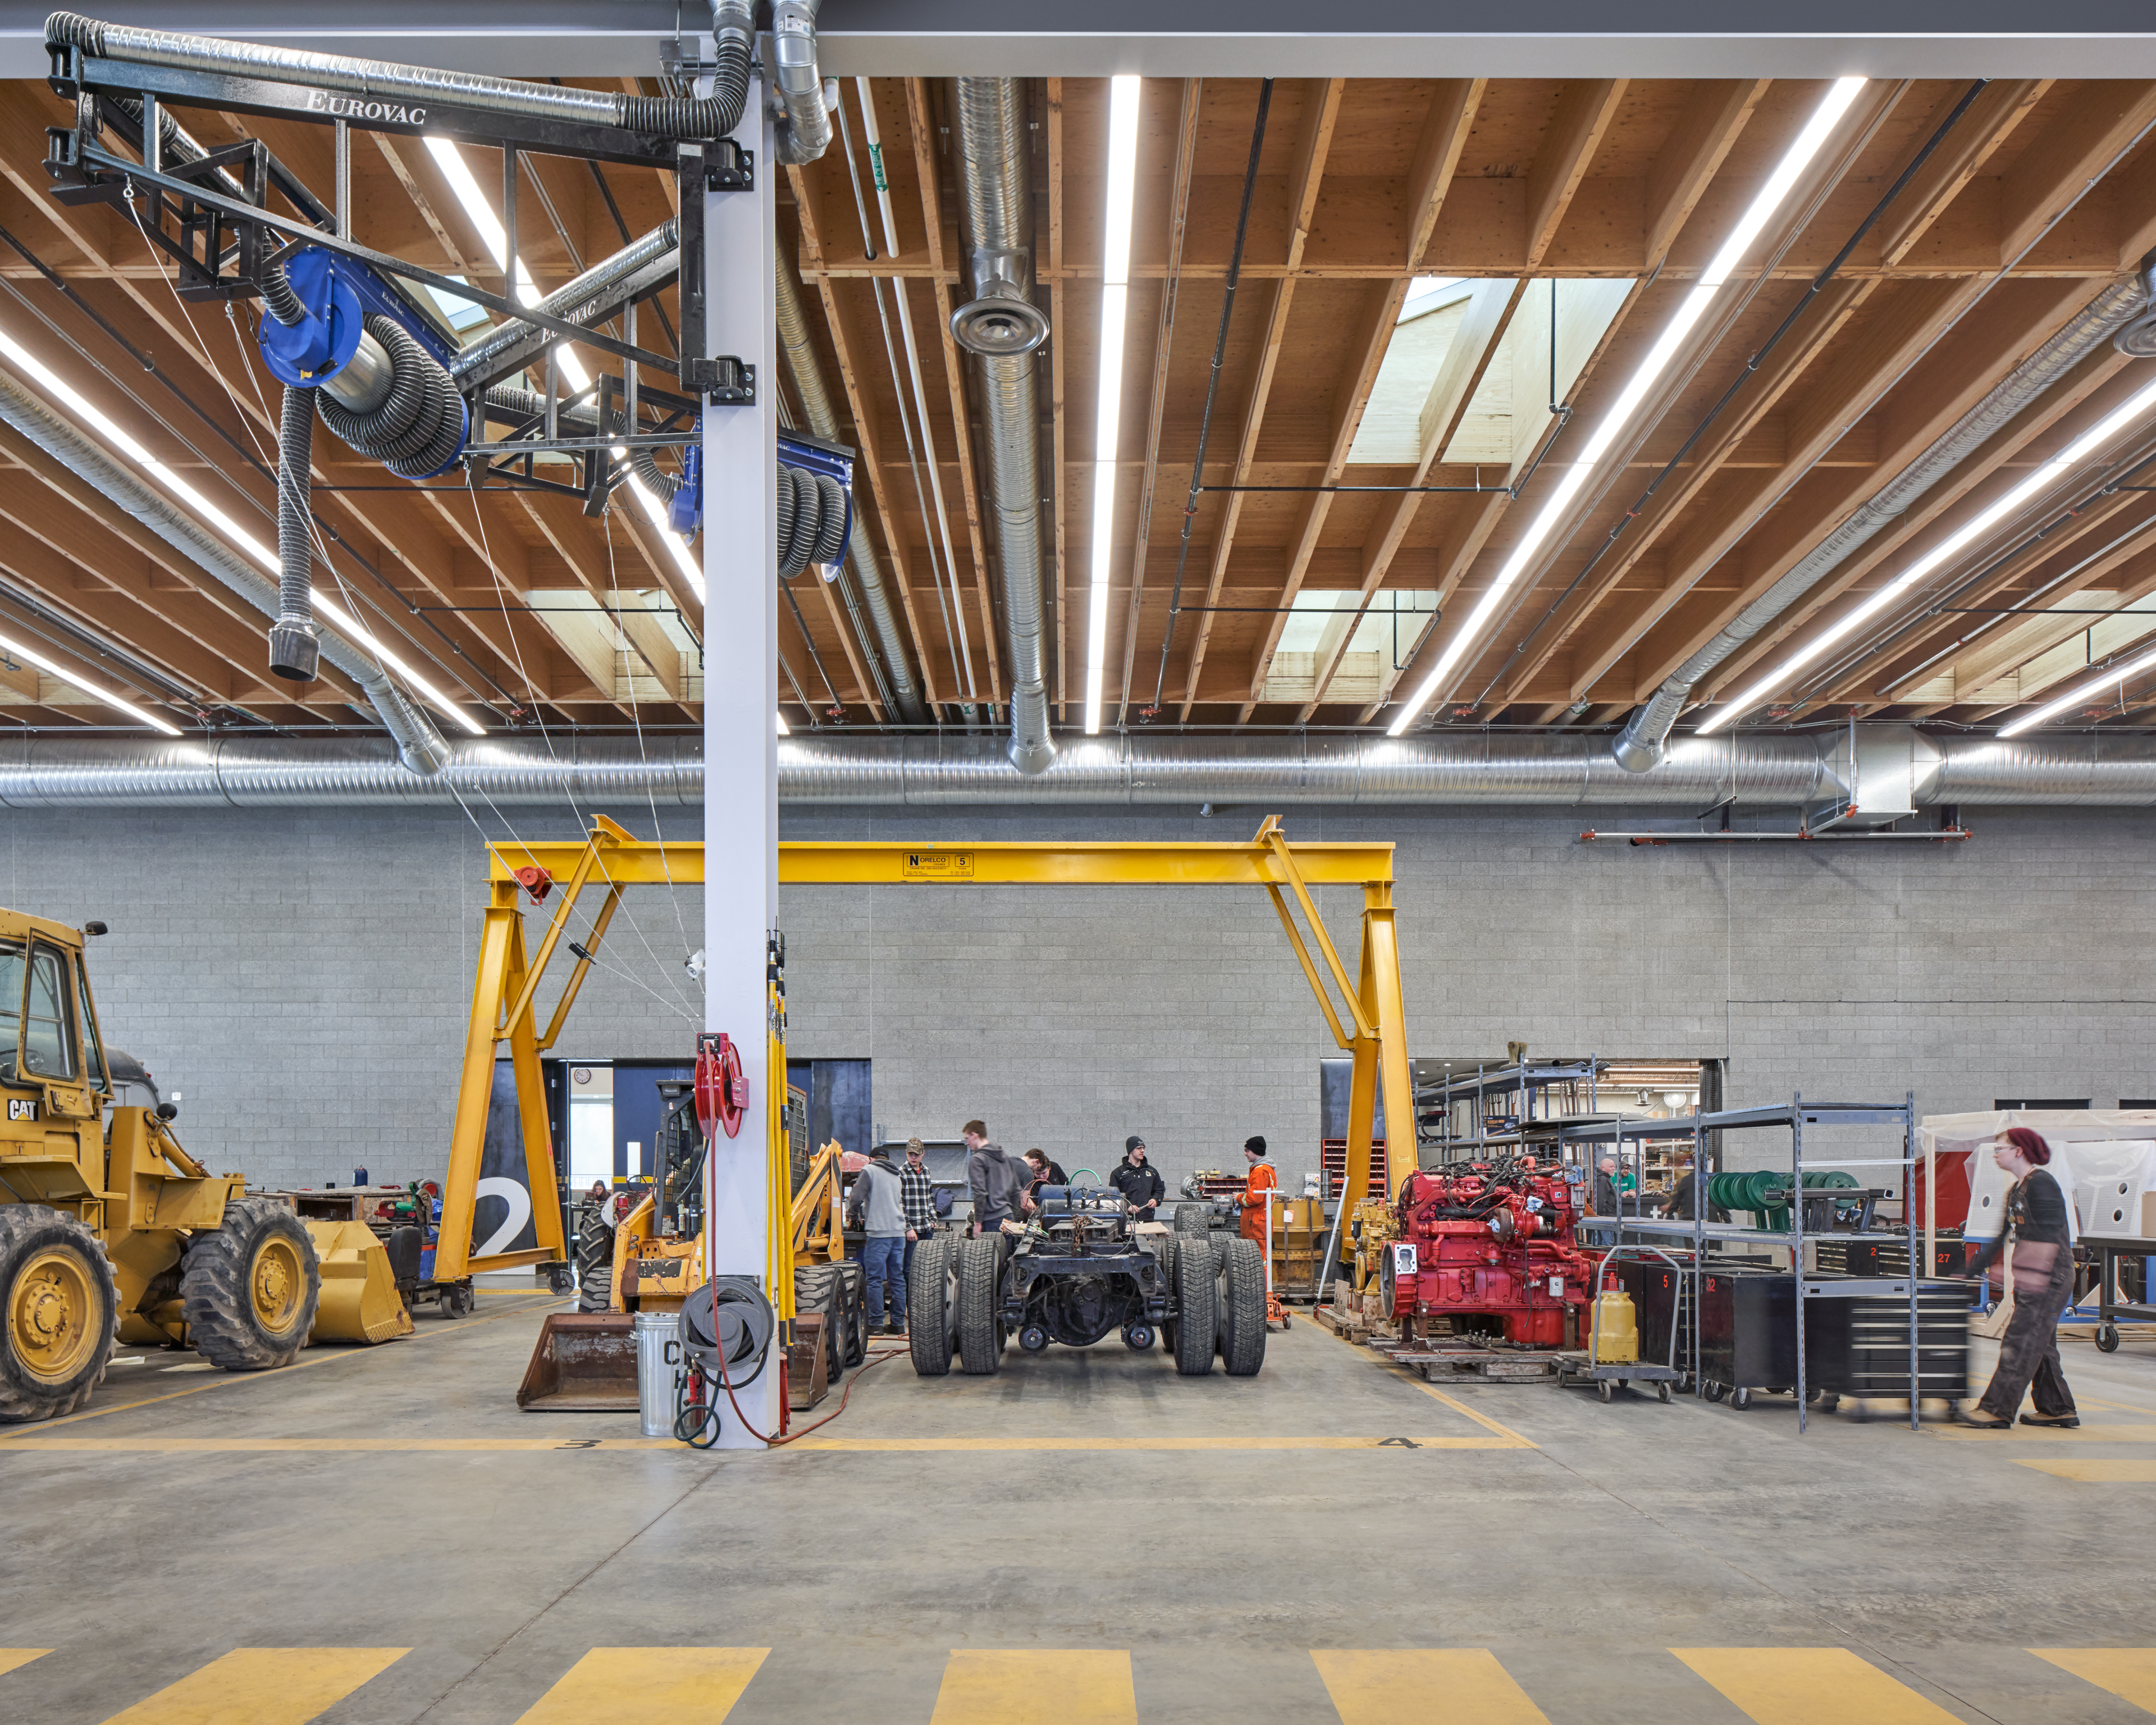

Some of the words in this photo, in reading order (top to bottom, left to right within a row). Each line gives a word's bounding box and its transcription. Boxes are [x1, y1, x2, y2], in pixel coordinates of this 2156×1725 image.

[304, 90, 426, 125] EUROVAC
[382, 291, 404, 317] EUROVAC
[910, 855, 946, 866] NORELCO
[10, 1099, 36, 1121] CAT
[473, 1177, 536, 1275] 2
[1871, 1248, 1876, 1256] 2
[1938, 1253, 1951, 1263] 27
[1664, 1275, 1668, 1288] 5
[1706, 1279, 1715, 1292] 32
[553, 1439, 603, 1449] 3
[1377, 1438, 1424, 1449] 4
